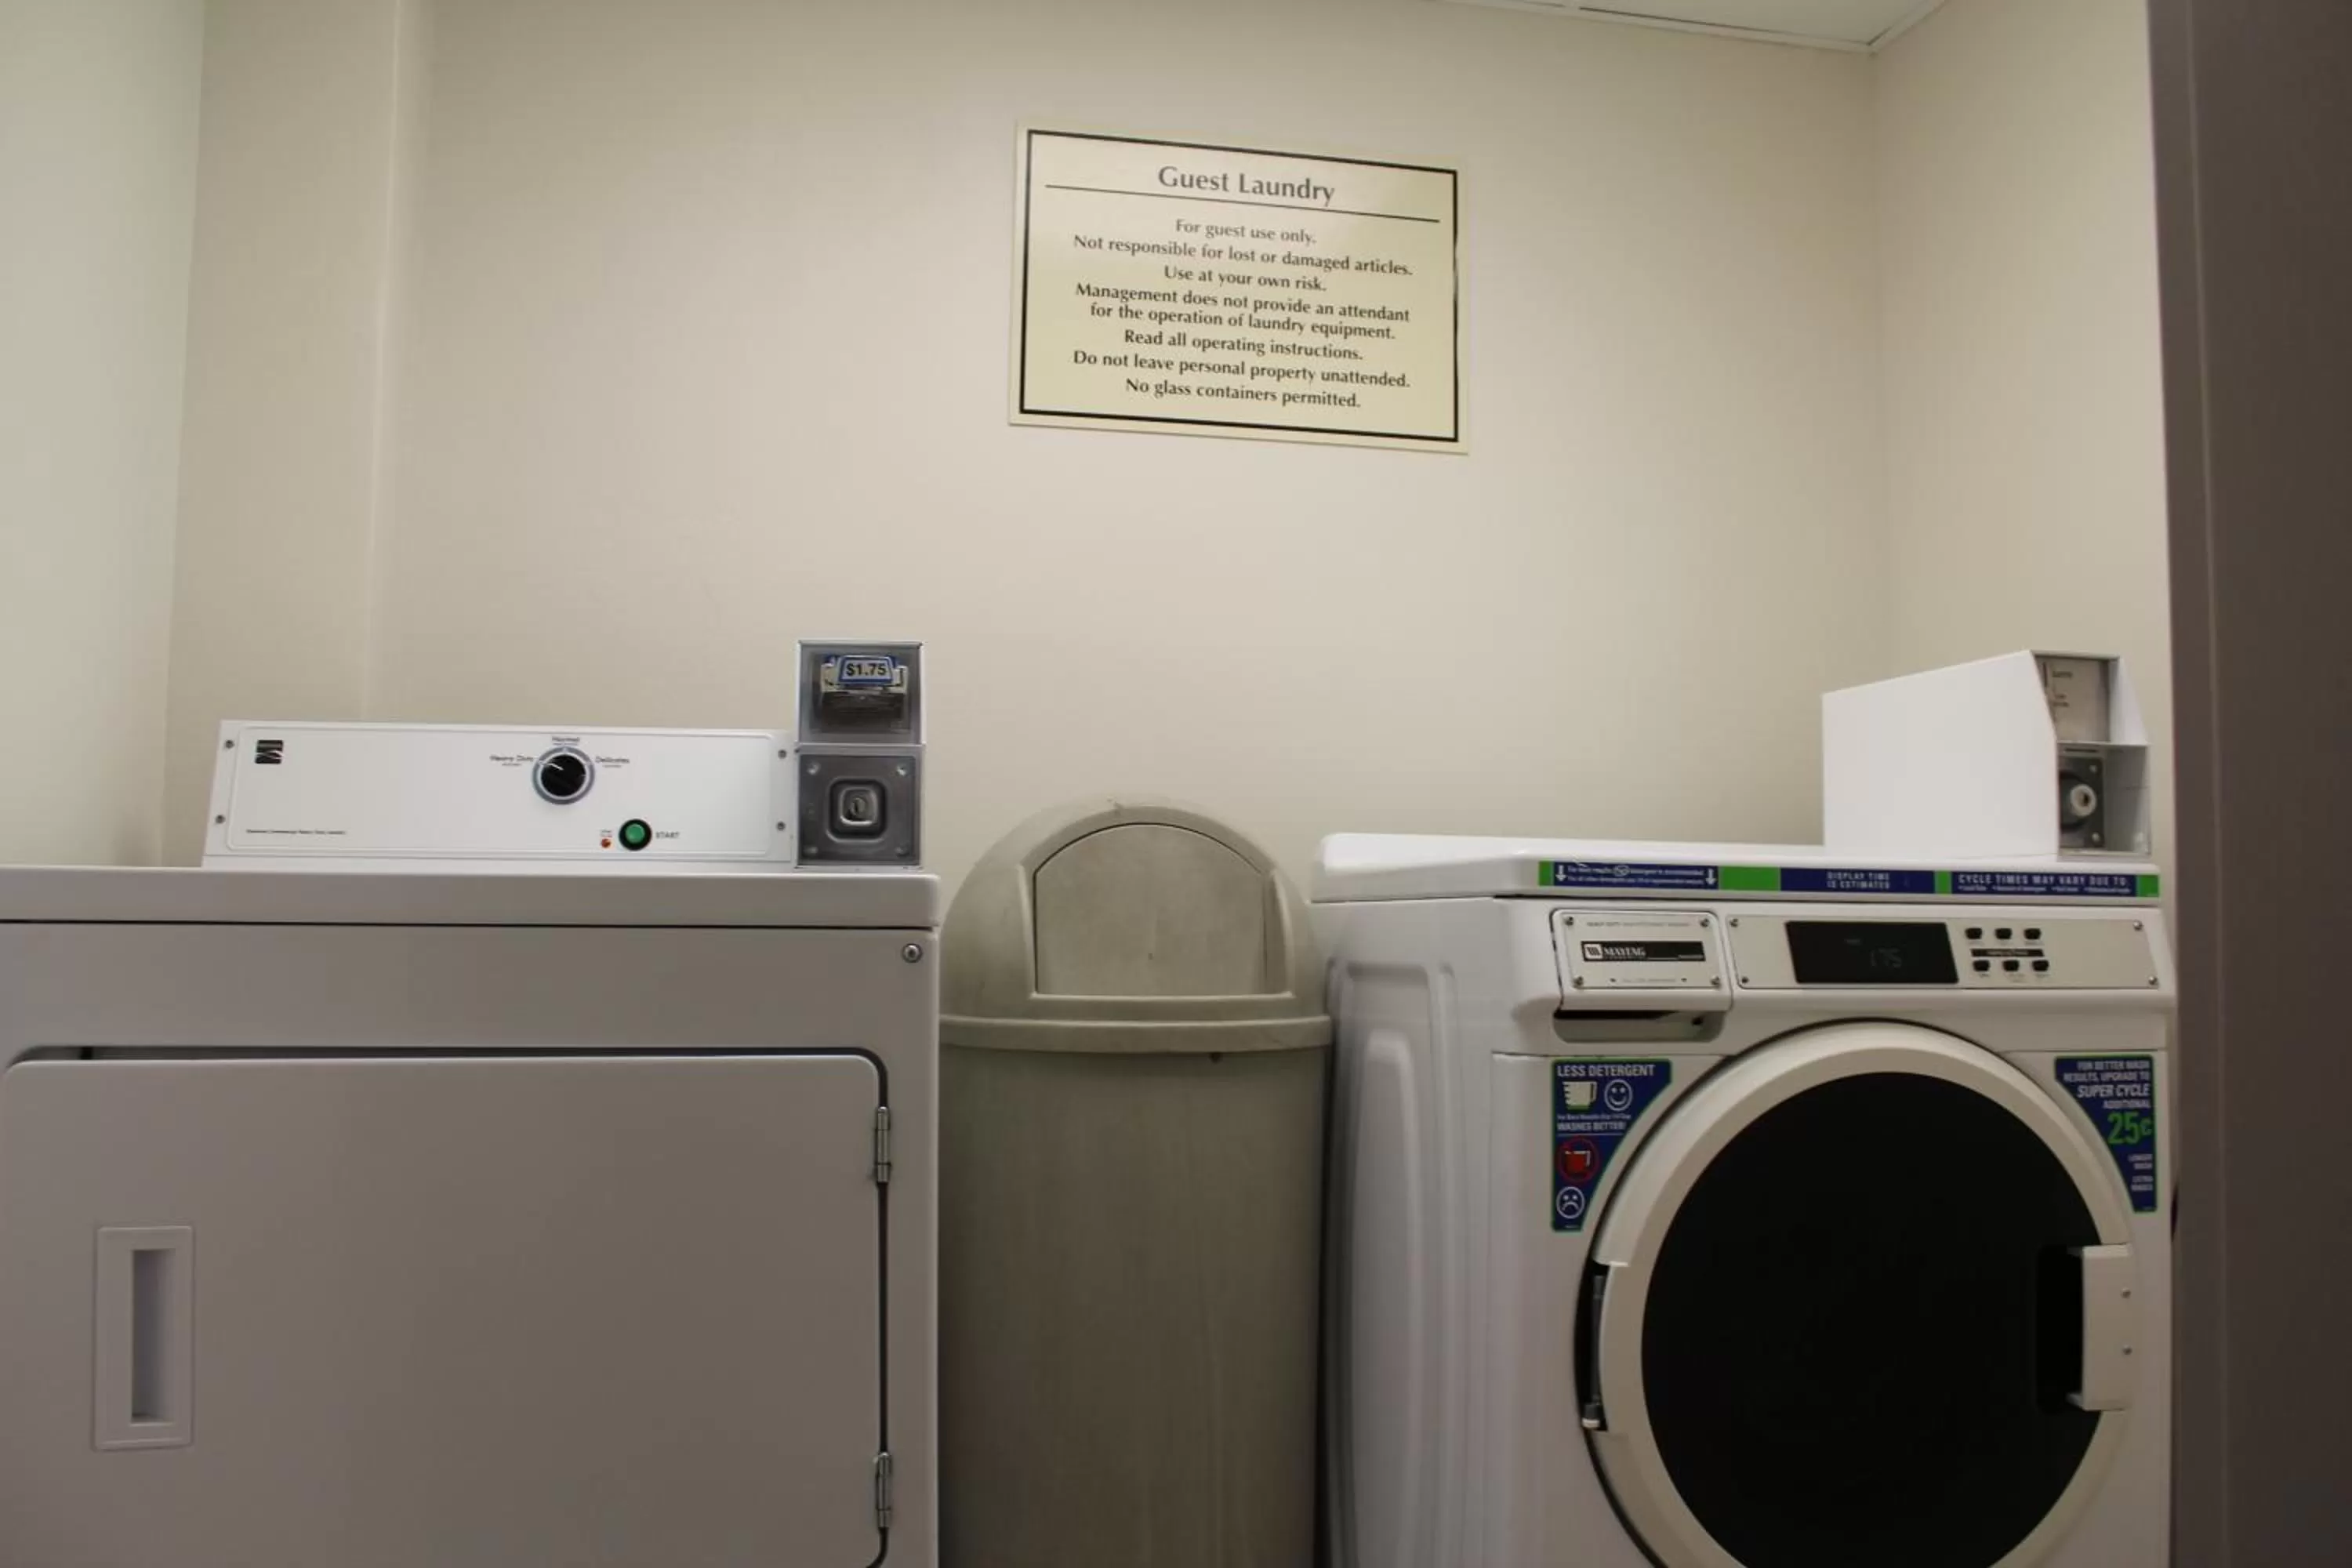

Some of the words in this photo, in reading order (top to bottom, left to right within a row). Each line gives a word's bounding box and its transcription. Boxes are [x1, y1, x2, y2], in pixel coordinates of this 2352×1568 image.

[1158, 165, 1230, 192] Guest
[1238, 172, 1335, 208] Laundry
[1175, 219, 1201, 233] For
[1204, 225, 1246, 239] guest
[1250, 228, 1276, 240] use
[1280, 228, 1316, 245] only.
[1074, 234, 1103, 250] Not
[1108, 241, 1197, 258] responsible
[1201, 244, 1224, 260] for
[1229, 245, 1255, 263] lost
[1260, 253, 1277, 264] or
[1281, 250, 1350, 273] damaged
[1354, 258, 1414, 276] articles.
[1164, 264, 1194, 281] Use
[1197, 269, 1213, 283] at
[1218, 272, 1254, 288] your
[1257, 275, 1291, 289] own
[1294, 275, 1327, 292] risk.
[1076, 281, 1178, 303] Management
[1181, 289, 1218, 307] does
[1222, 296, 1249, 308] not
[1253, 297, 1312, 314] provide
[1315, 303, 1334, 316] an
[1338, 304, 1410, 325] attendant
[1091, 301, 1114, 318] for
[1118, 303, 1144, 320] the
[1147, 310, 1224, 326] operation
[1227, 313, 1245, 327] of
[1247, 313, 1305, 336] laundry
[1310, 321, 1396, 340] equipment.
[1123, 328, 1163, 346] Read
[1167, 332, 1187, 347] all
[1191, 337, 1266, 358] operating
[1269, 338, 1363, 361] instructions.
[1073, 350, 1098, 365] Do
[1102, 354, 1129, 368] not
[1133, 352, 1175, 371] leave
[1178, 360, 1246, 376] personal
[1250, 366, 1316, 384] property
[1320, 370, 1410, 388] unattended.
[1125, 377, 1150, 394] No
[1153, 379, 1192, 399] glass
[1196, 385, 1278, 402] containers
[1282, 390, 1361, 408] permitted.
[846, 663, 887, 677] $1.75
[1827, 870, 1864, 880] DISPLAY
[1868, 871, 1889, 880] TIME
[1958, 873, 1992, 884] CYCLE
[1995, 874, 2028, 884] TIMES
[2032, 875, 2055, 884] MAY
[2059, 875, 2085, 885] VARY
[2089, 876, 2111, 886] DUE
[1604, 946, 1646, 956] MAYTAG
[1557, 1065, 1586, 1077] LESS
[1588, 1064, 1656, 1077] DETERGENT
[2076, 1084, 2114, 1098] SUPER
[2116, 1083, 2151, 1097] CYCLE
